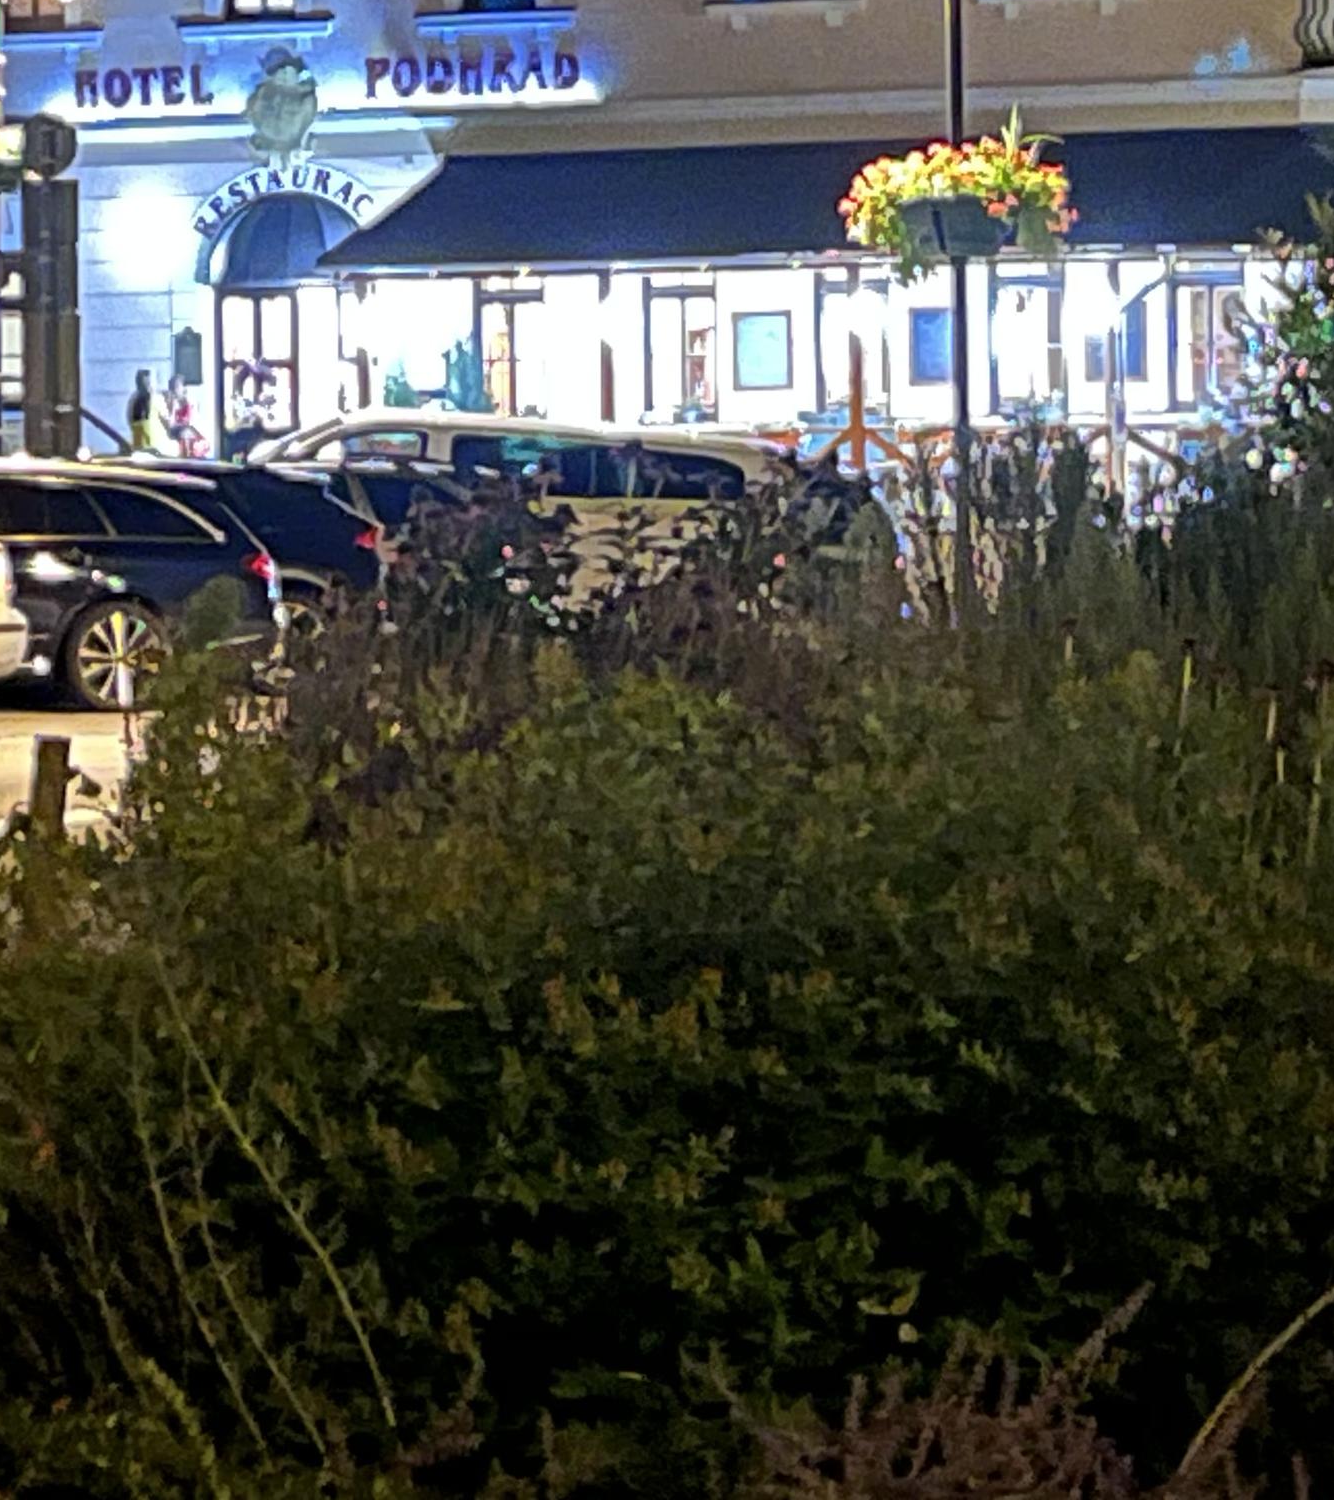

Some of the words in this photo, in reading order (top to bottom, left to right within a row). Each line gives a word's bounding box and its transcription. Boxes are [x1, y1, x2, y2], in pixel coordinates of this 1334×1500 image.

[75, 65, 214, 108] HOTEL
[365, 46, 580, 99] PODHRAD
[193, 166, 374, 238] RESTAURAC
